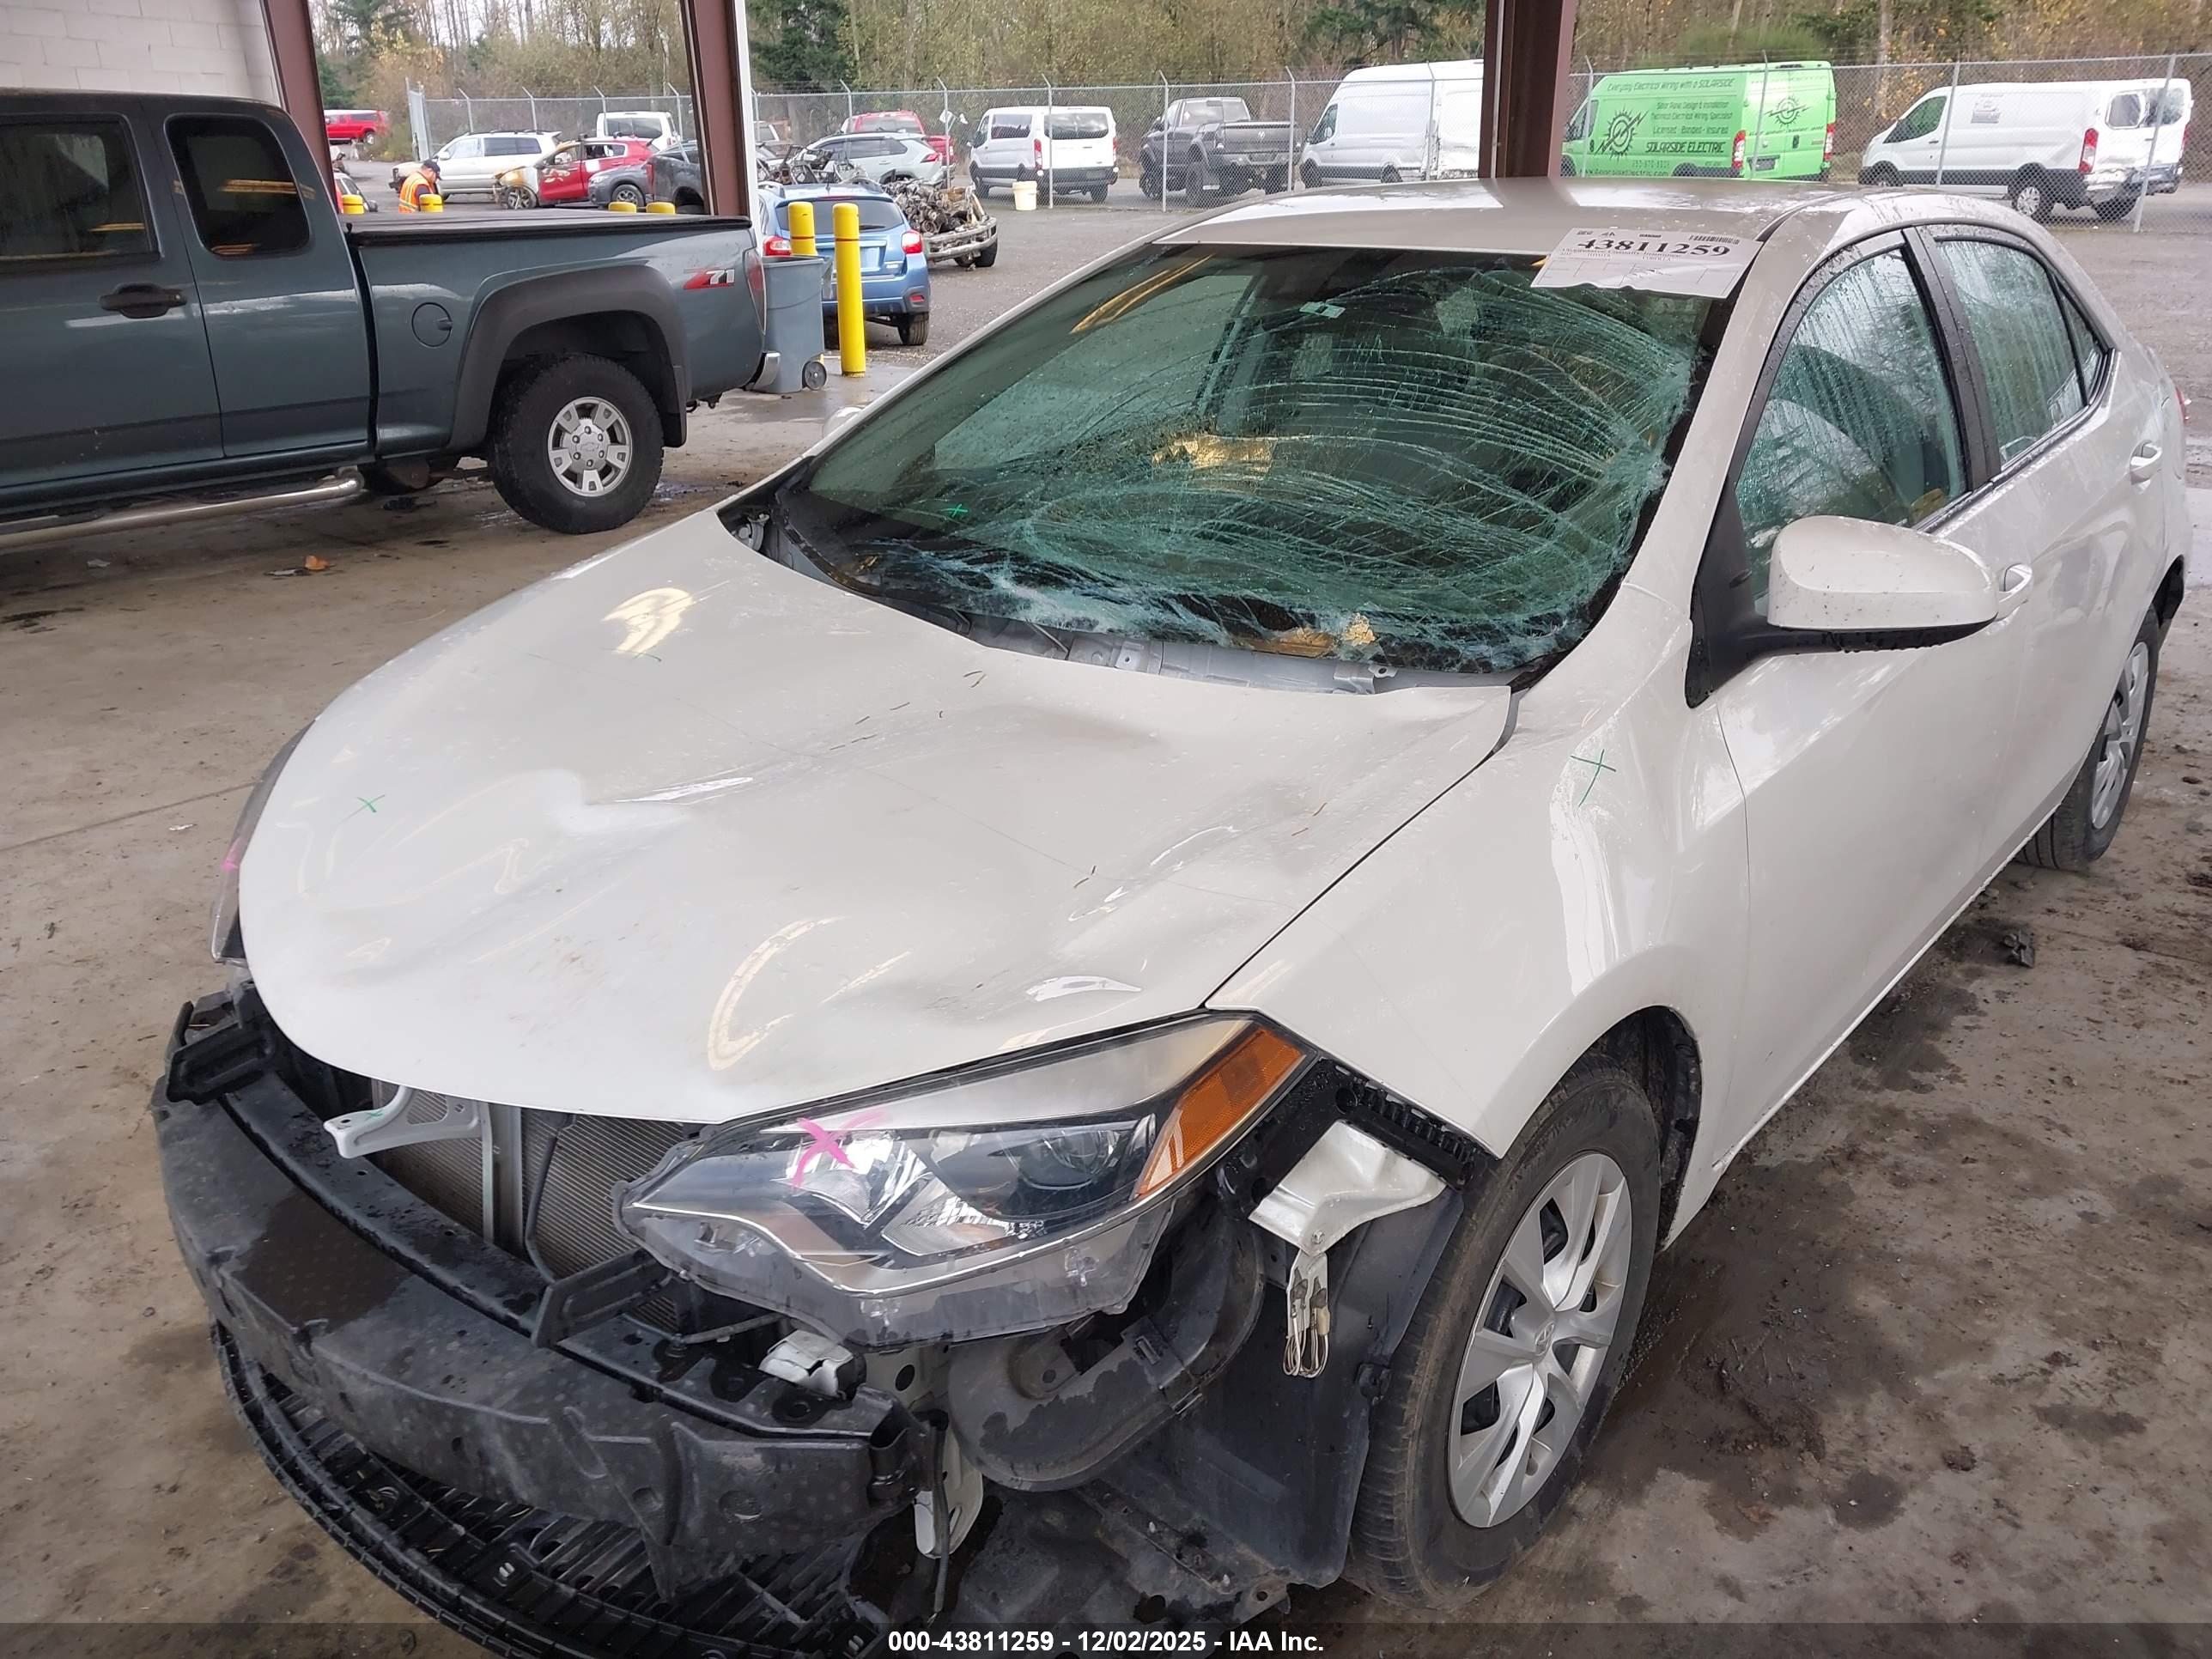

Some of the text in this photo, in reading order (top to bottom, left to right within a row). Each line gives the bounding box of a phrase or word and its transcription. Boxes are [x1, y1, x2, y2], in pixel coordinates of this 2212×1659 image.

[1644, 141, 1726, 153] SOLARSIDE ELECTRIC
[1577, 239, 1731, 257] 43811259
